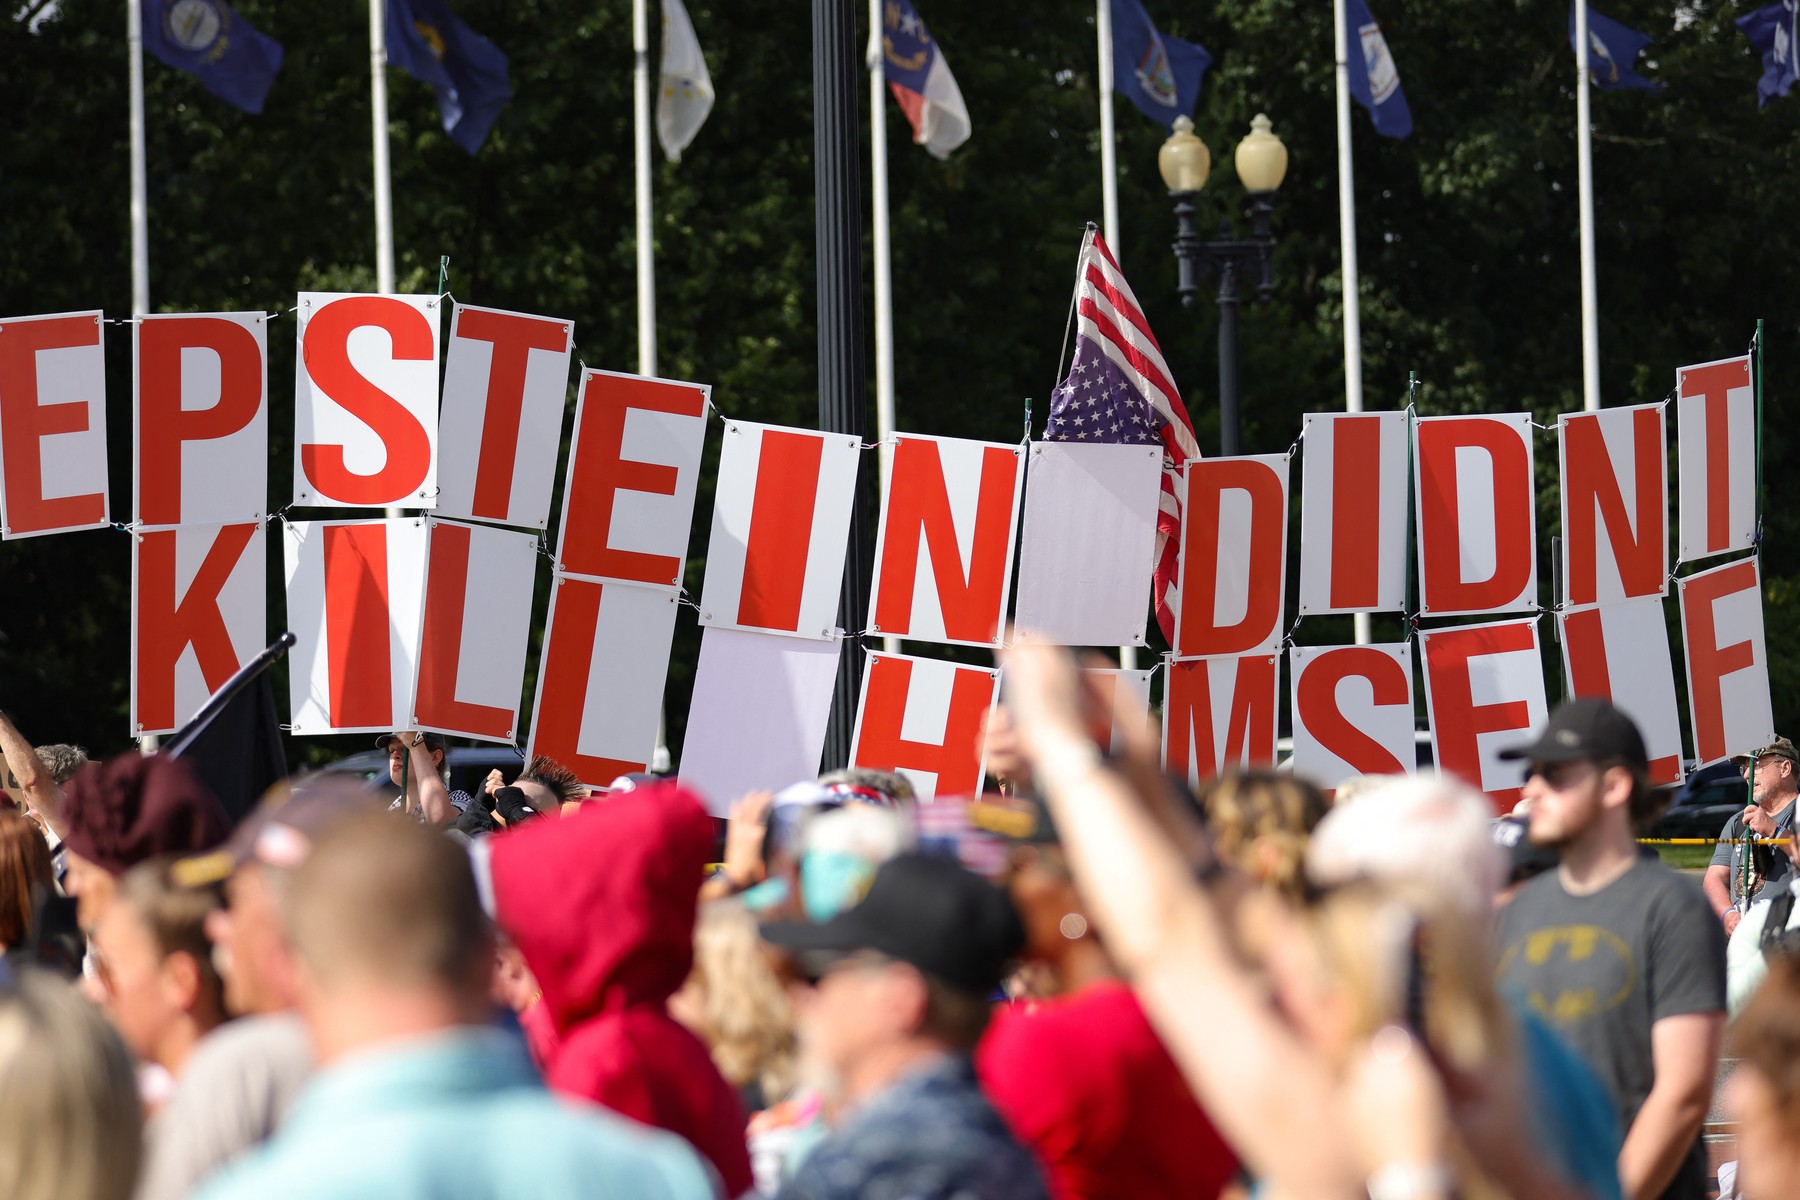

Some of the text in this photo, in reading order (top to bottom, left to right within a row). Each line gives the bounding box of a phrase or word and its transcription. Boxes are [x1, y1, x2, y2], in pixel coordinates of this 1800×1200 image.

[0, 296, 1750, 655] EPSTEIN DIDNT
[137, 523, 1758, 816] KILL HMSELF
